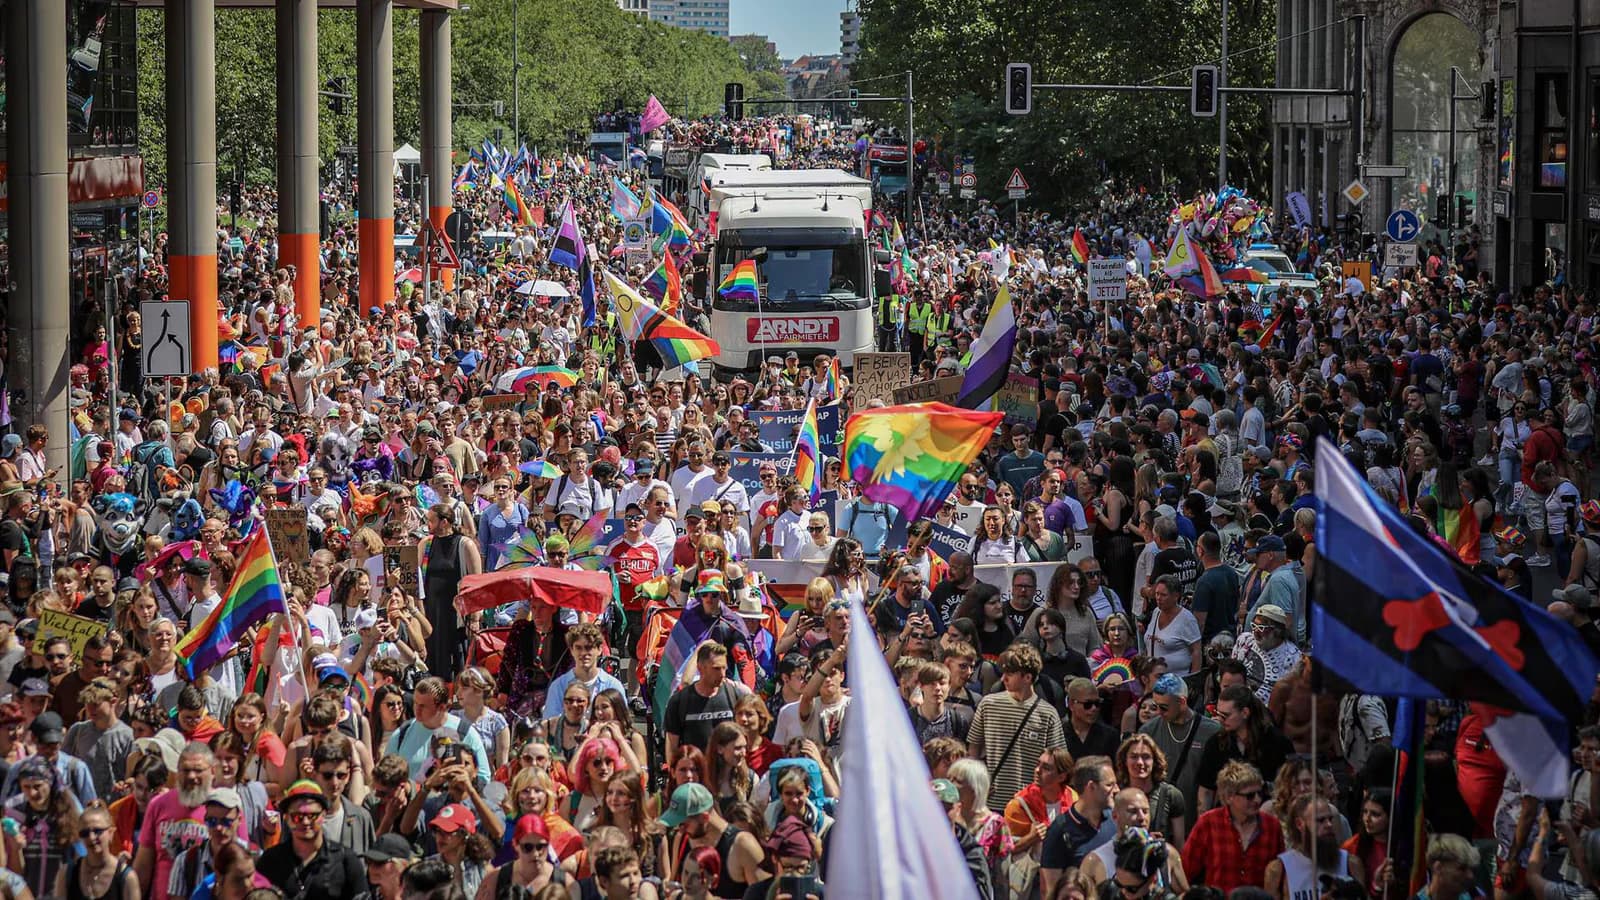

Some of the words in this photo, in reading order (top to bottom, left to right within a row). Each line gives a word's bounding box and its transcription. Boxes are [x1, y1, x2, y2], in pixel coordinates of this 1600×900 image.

[964, 177, 973, 185] 30
[1097, 286, 1120, 297] JETZT
[753, 319, 834, 341] ARNDT
[856, 356, 870, 370] IF
[857, 370, 885, 385] GAY
[43, 611, 101, 636] Vielfalt
